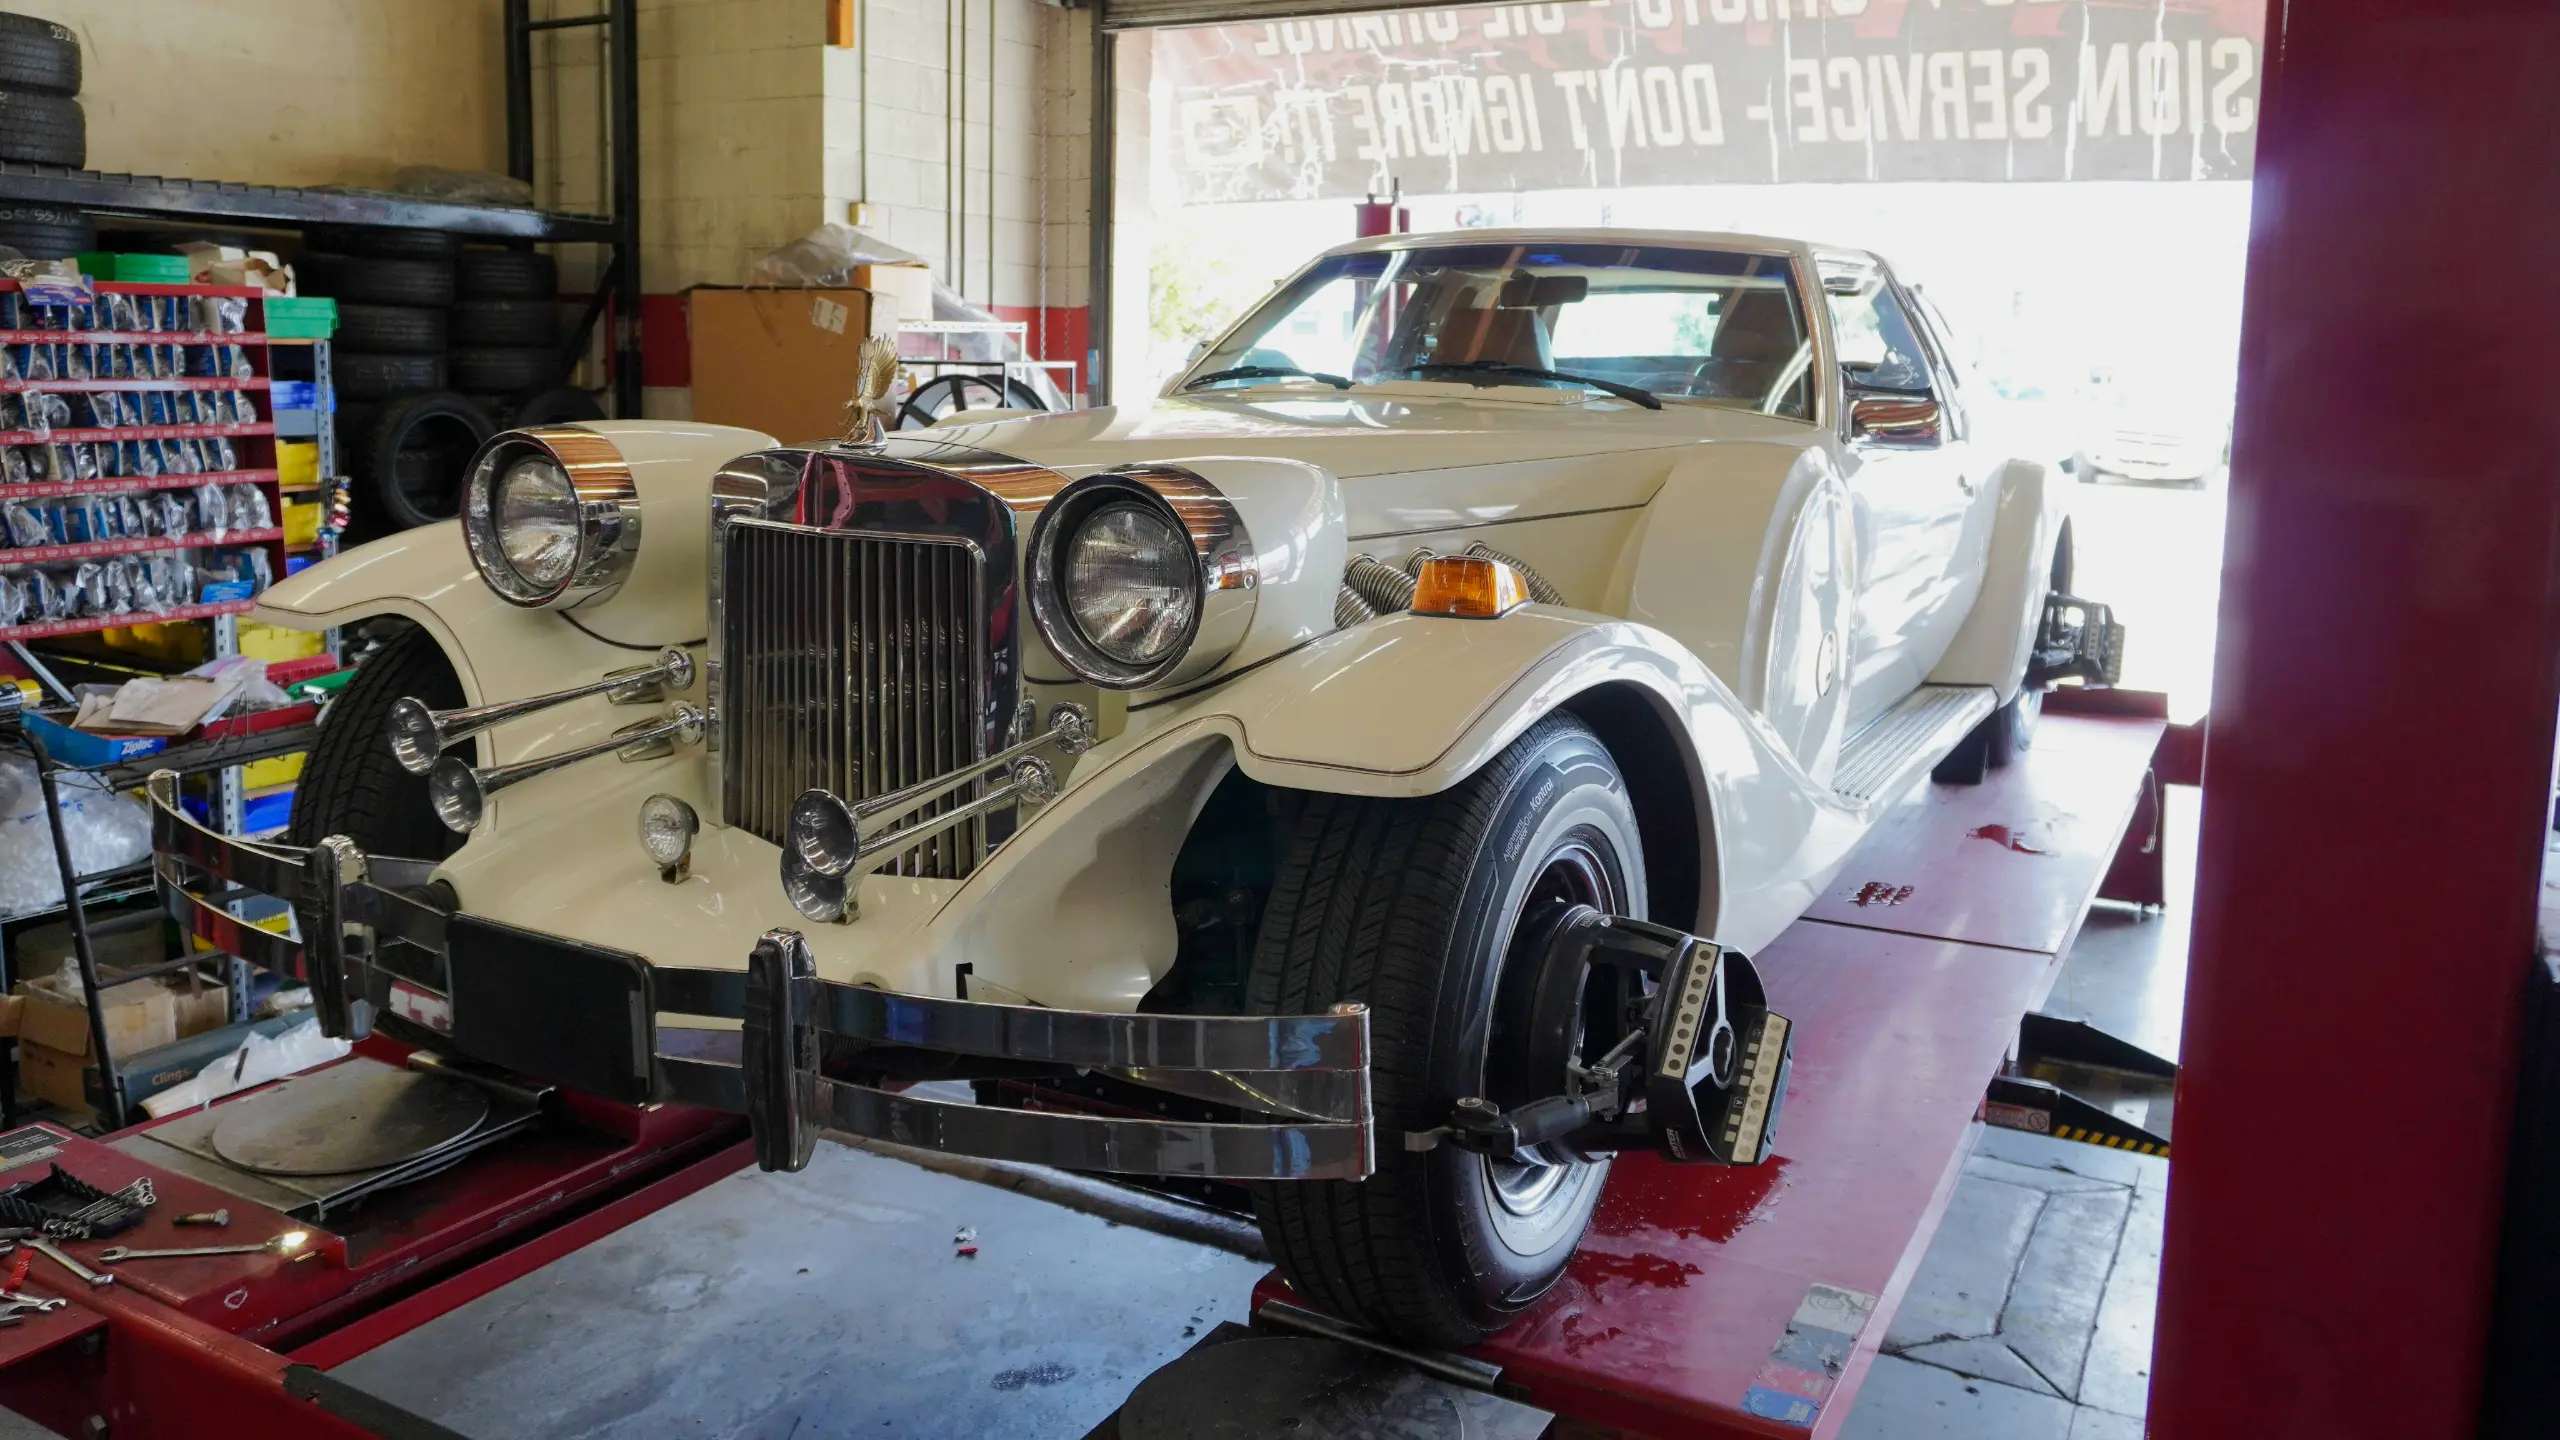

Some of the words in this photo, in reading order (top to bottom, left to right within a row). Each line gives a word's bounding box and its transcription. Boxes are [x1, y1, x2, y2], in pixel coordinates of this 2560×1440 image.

[121, 739, 154, 755] Ziploc
[1529, 777, 1553, 811] Kontrol
[1503, 818, 1524, 862] Alignment
[1509, 828, 1528, 861] Indicator
